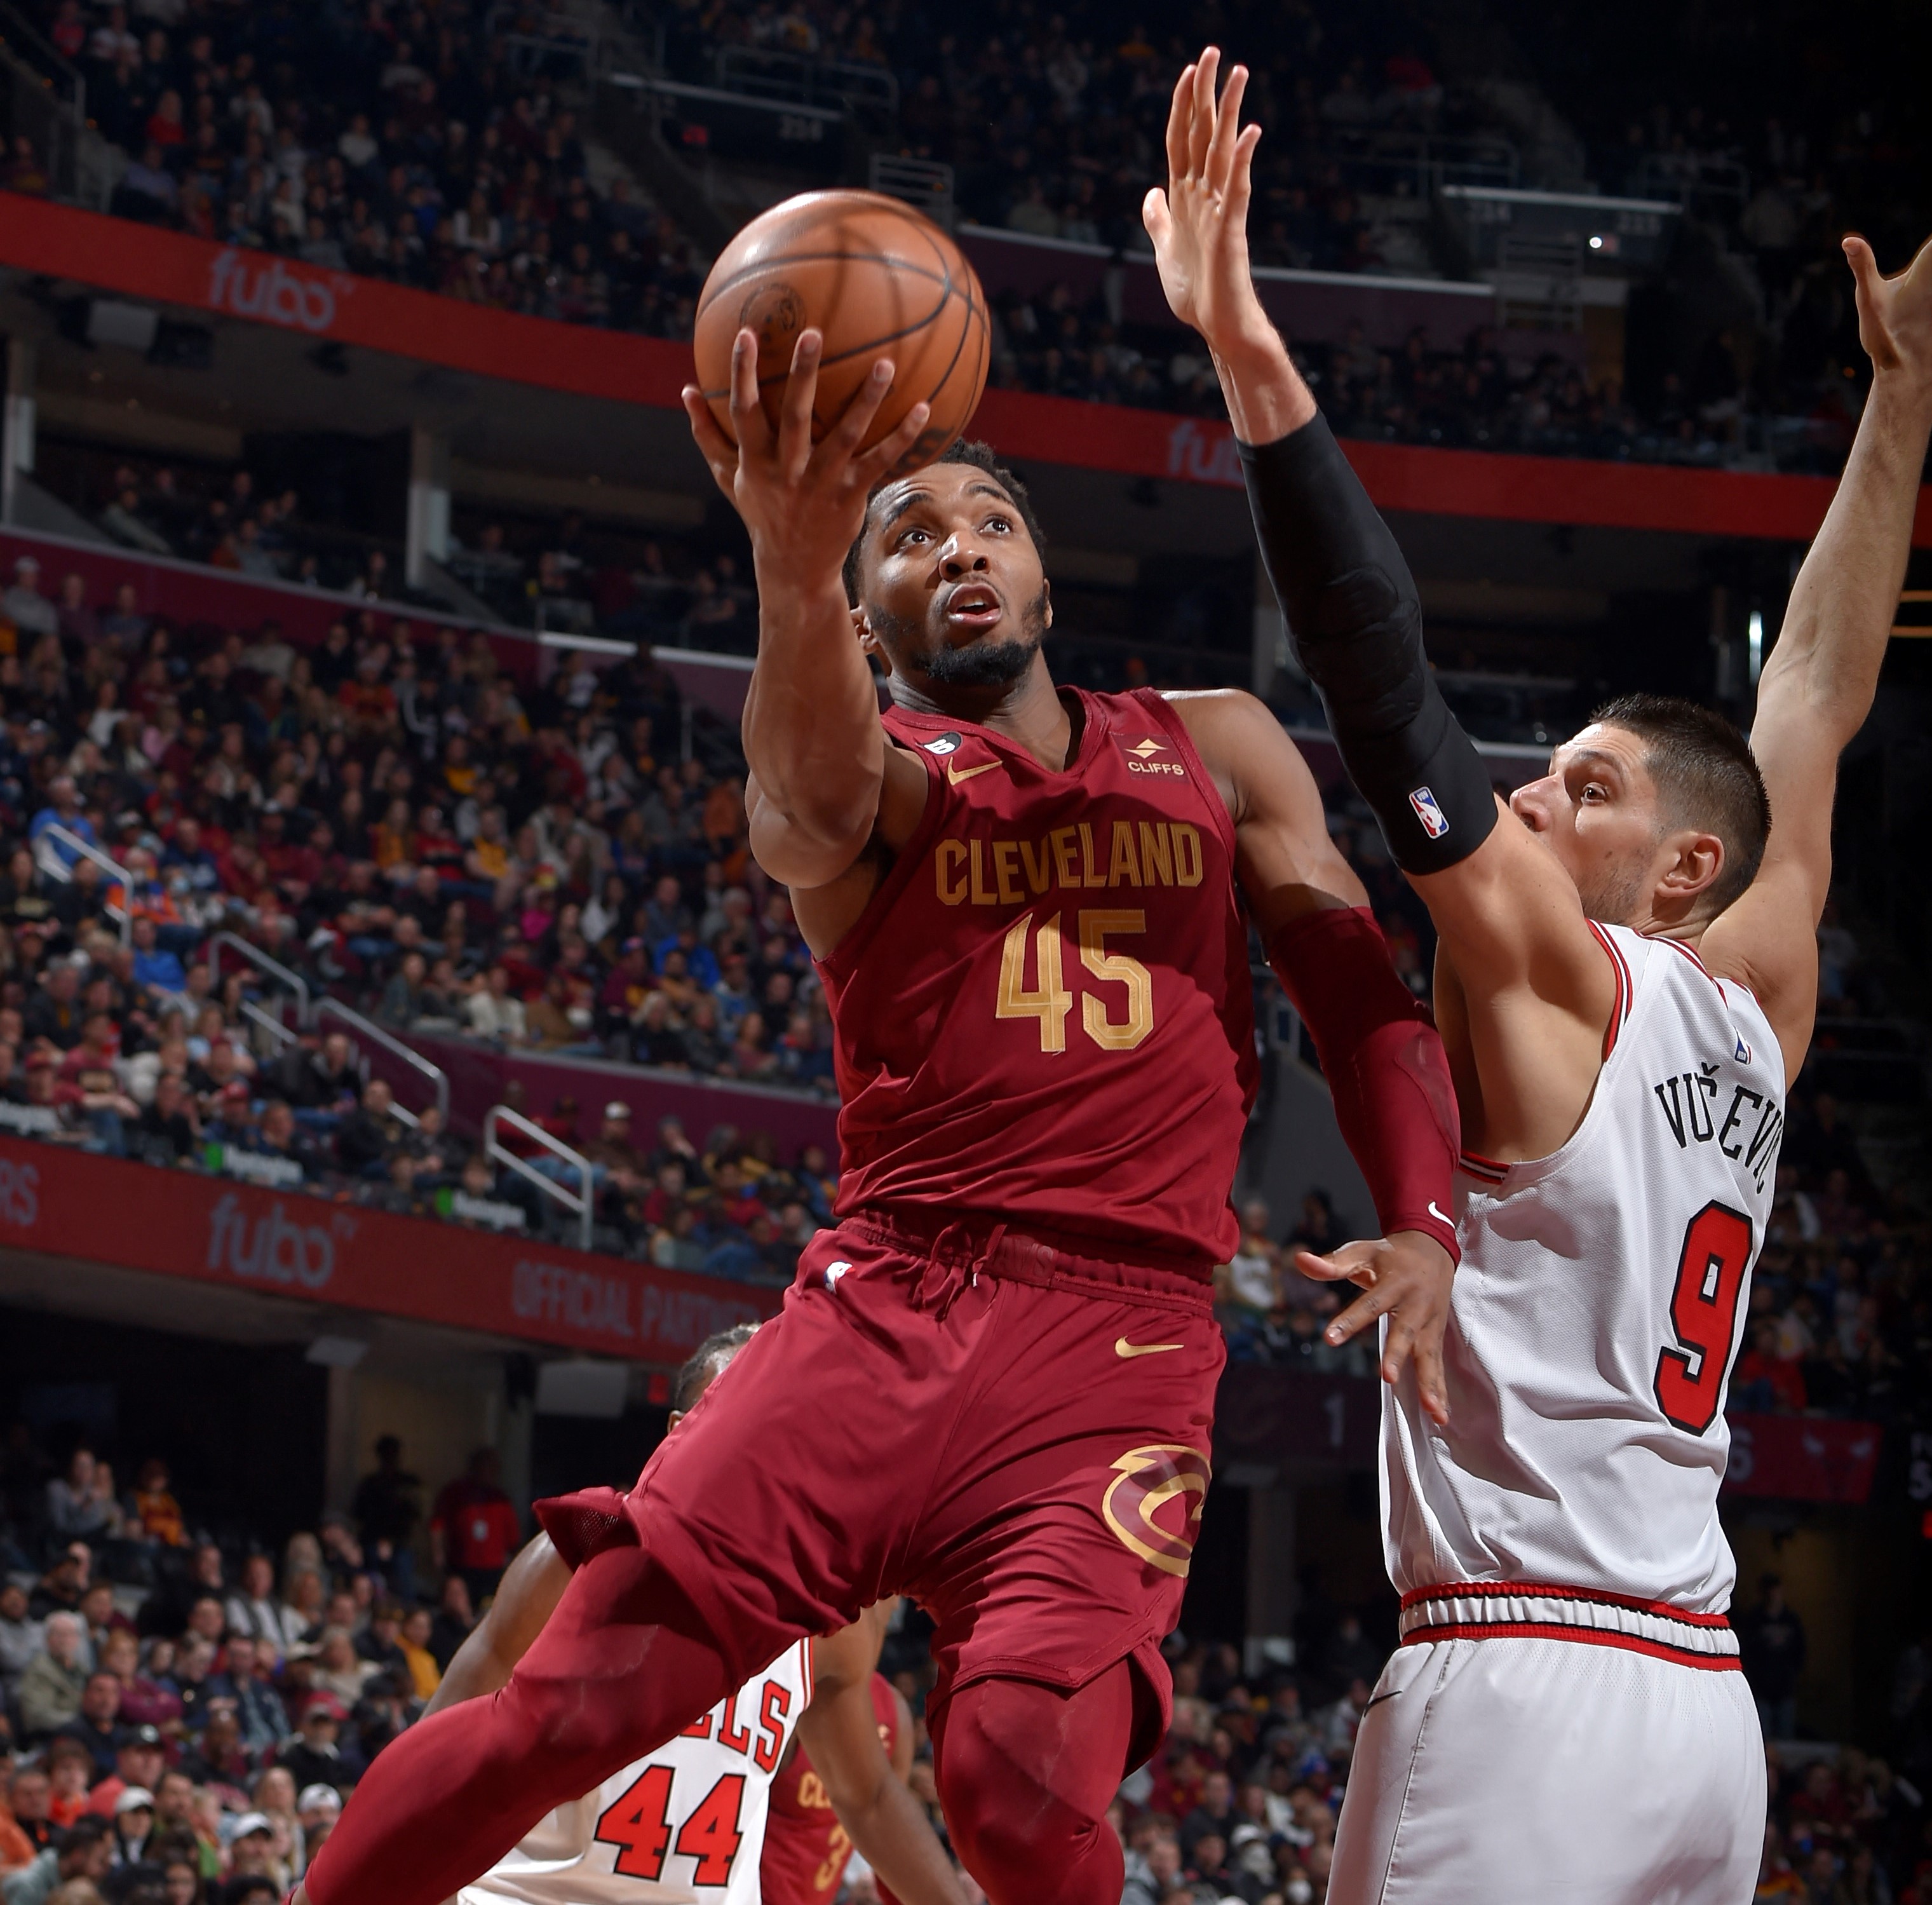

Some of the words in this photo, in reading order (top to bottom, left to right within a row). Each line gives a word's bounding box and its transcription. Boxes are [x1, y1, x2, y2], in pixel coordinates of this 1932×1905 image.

[210, 250, 335, 330] fubo
[1128, 761, 1184, 776] CLIFFS
[935, 820, 1203, 905] CLEVELAND
[996, 909, 1154, 1052] 45
[207, 1192, 335, 1289] fubo
[512, 1259, 634, 1338] OFFICIAL
[1653, 1199, 1753, 1437] 9
[594, 1765, 746, 1887] 44
[814, 1822, 851, 1892] 3
